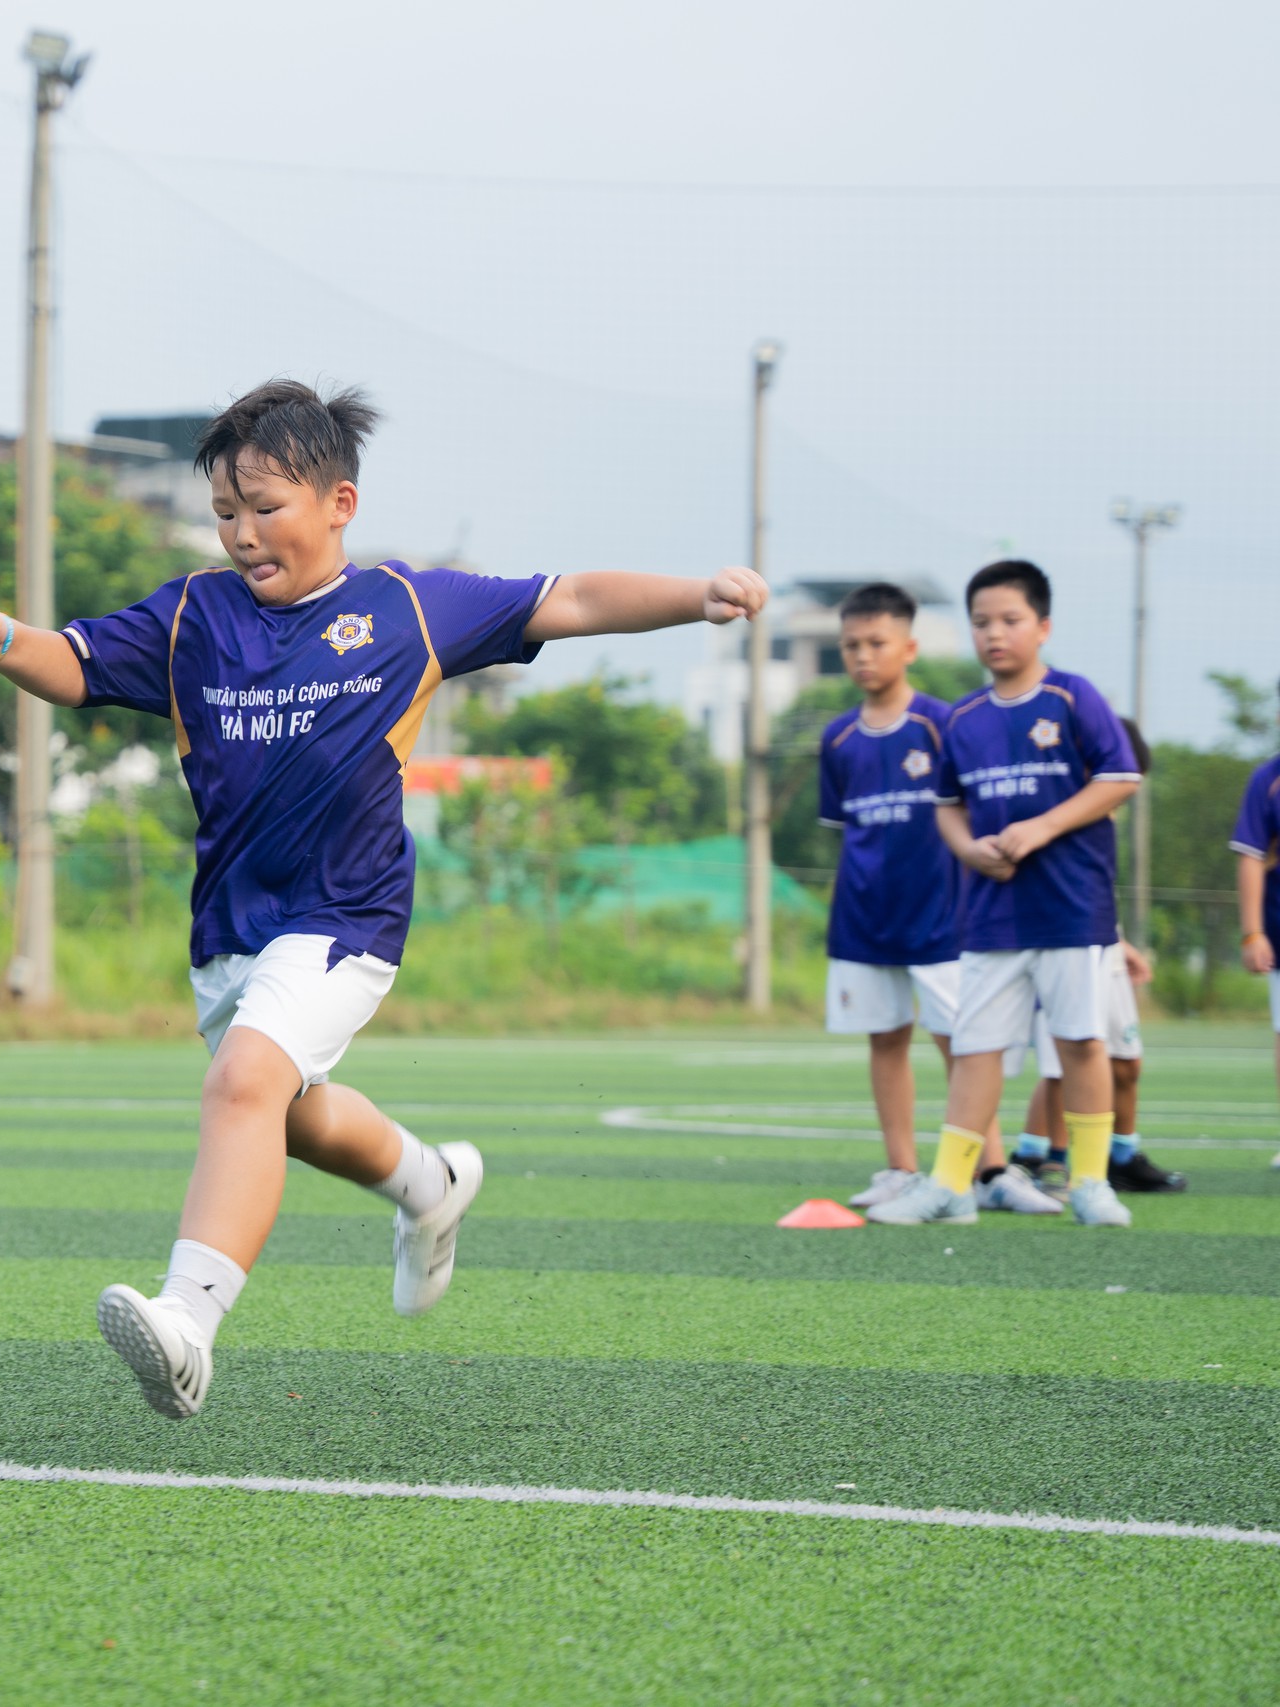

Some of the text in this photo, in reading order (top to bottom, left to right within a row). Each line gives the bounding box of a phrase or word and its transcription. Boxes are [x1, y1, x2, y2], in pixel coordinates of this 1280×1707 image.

[337, 618, 363, 627] HANOI
[239, 685, 274, 706] BÓNG
[277, 684, 295, 706] ĐÁ
[298, 681, 339, 704] CỘNG
[342, 673, 383, 694] ĐỒNG
[220, 708, 315, 745] HÀ NỘI FC
[1020, 777, 1038, 795] FC
